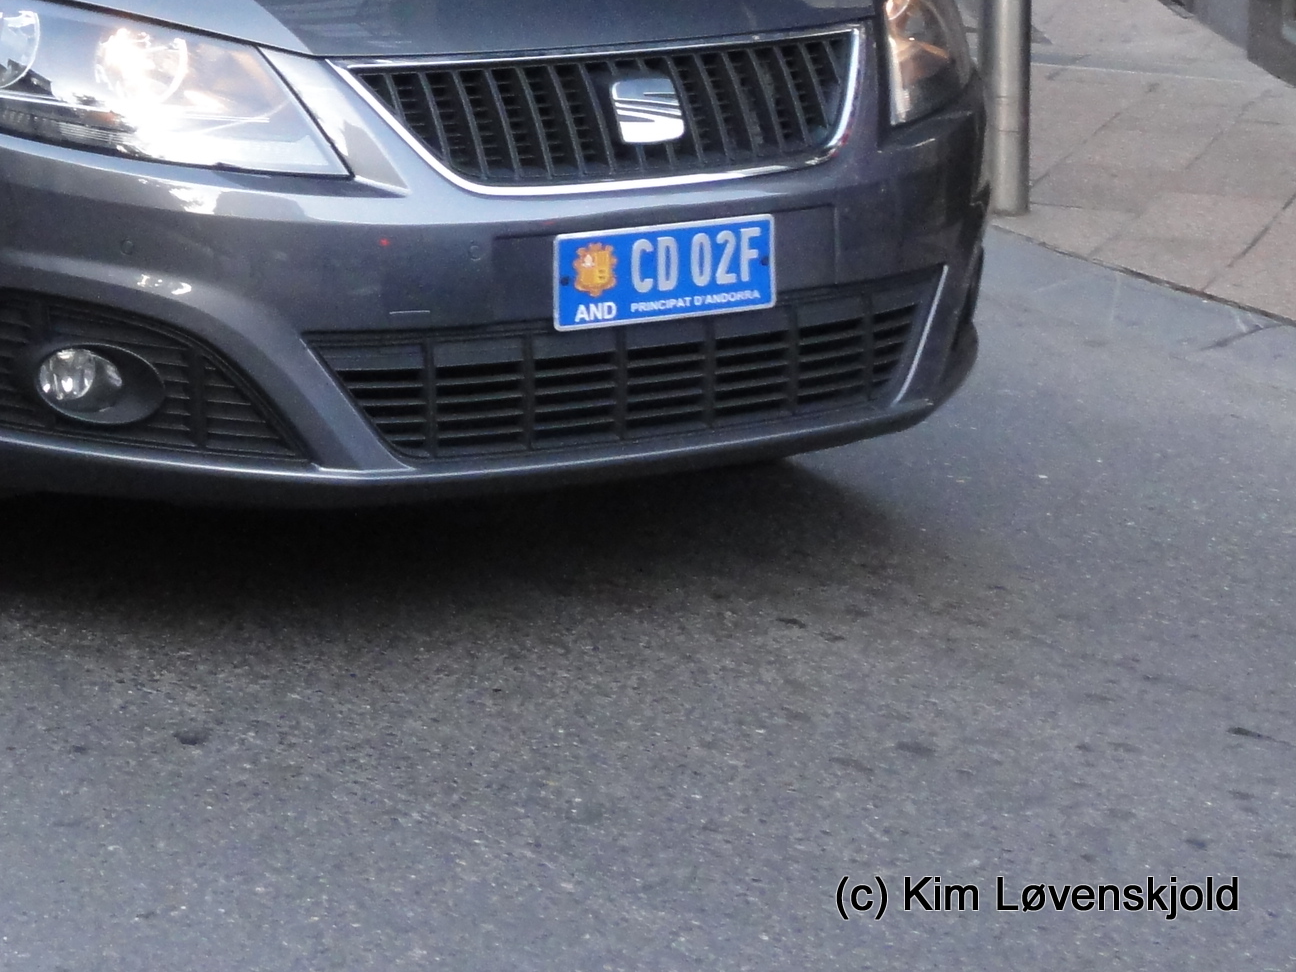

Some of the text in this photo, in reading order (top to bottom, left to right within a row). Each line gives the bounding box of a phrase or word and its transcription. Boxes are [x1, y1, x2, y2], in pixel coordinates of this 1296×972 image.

[630, 226, 762, 294] CD 02F
[574, 288, 761, 323] AND PRINCIPAT D'ANDORRA
